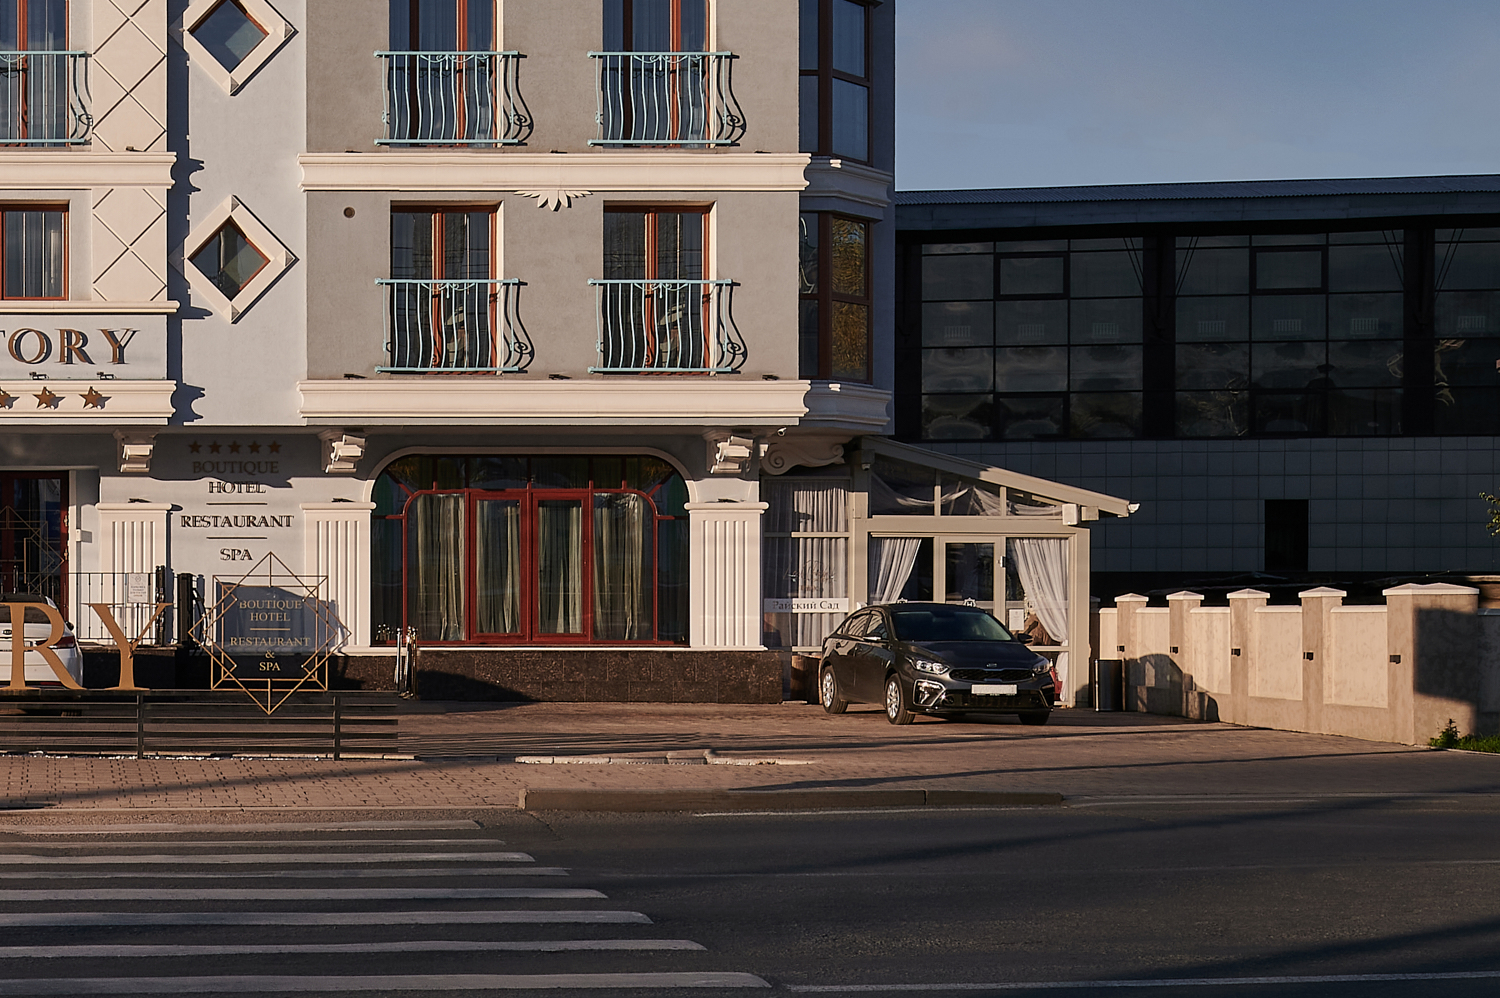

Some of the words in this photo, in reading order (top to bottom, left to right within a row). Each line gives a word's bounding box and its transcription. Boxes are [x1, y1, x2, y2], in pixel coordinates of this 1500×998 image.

[192, 460, 279, 475] BOUTIQUE
[208, 481, 266, 494] HOTEL
[180, 515, 294, 528] RESTAURANT
[220, 549, 253, 561] SPA
[239, 600, 303, 610] BOUTIQUE
[772, 600, 817, 610] Райский
[819, 600, 840, 611] Сад
[250, 612, 291, 622] HOTEL
[230, 637, 311, 647] RESTAURANT
[265, 650, 275, 659] &
[259, 662, 281, 671] SPA
